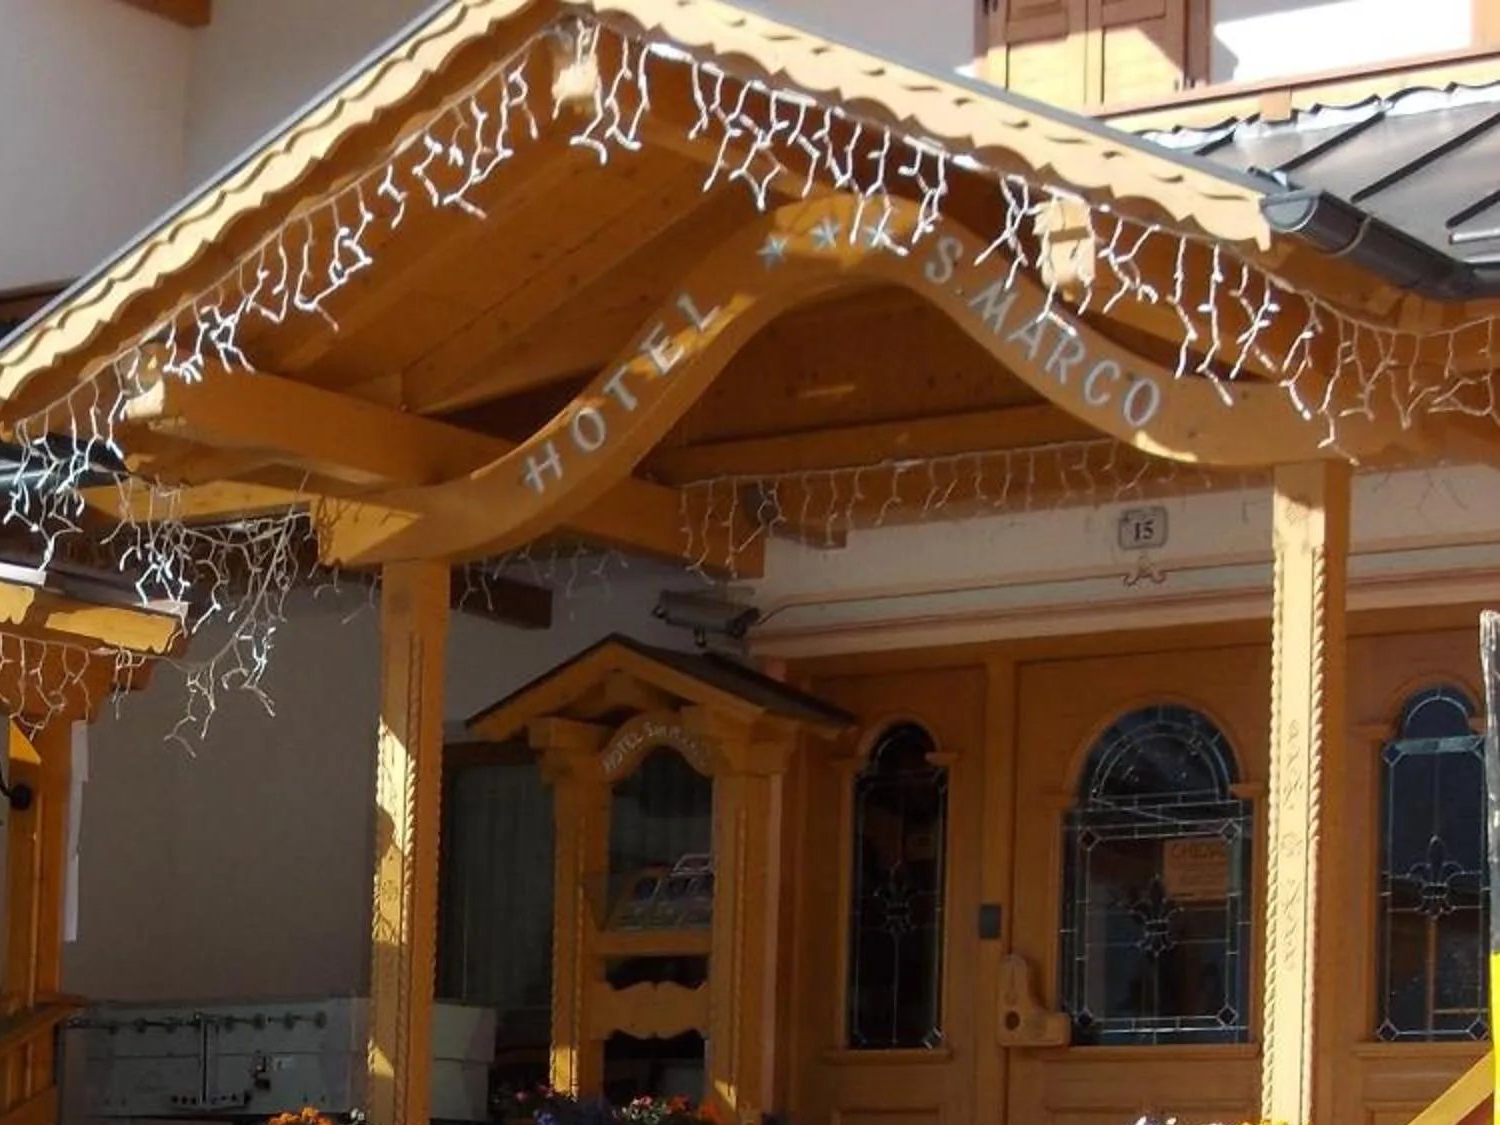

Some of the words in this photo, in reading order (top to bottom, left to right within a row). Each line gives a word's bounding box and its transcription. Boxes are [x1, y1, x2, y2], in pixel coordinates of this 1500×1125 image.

[524, 292, 722, 494] HOTEL
[967, 280, 1161, 427] MARCO
[1134, 519, 1155, 542] 15
